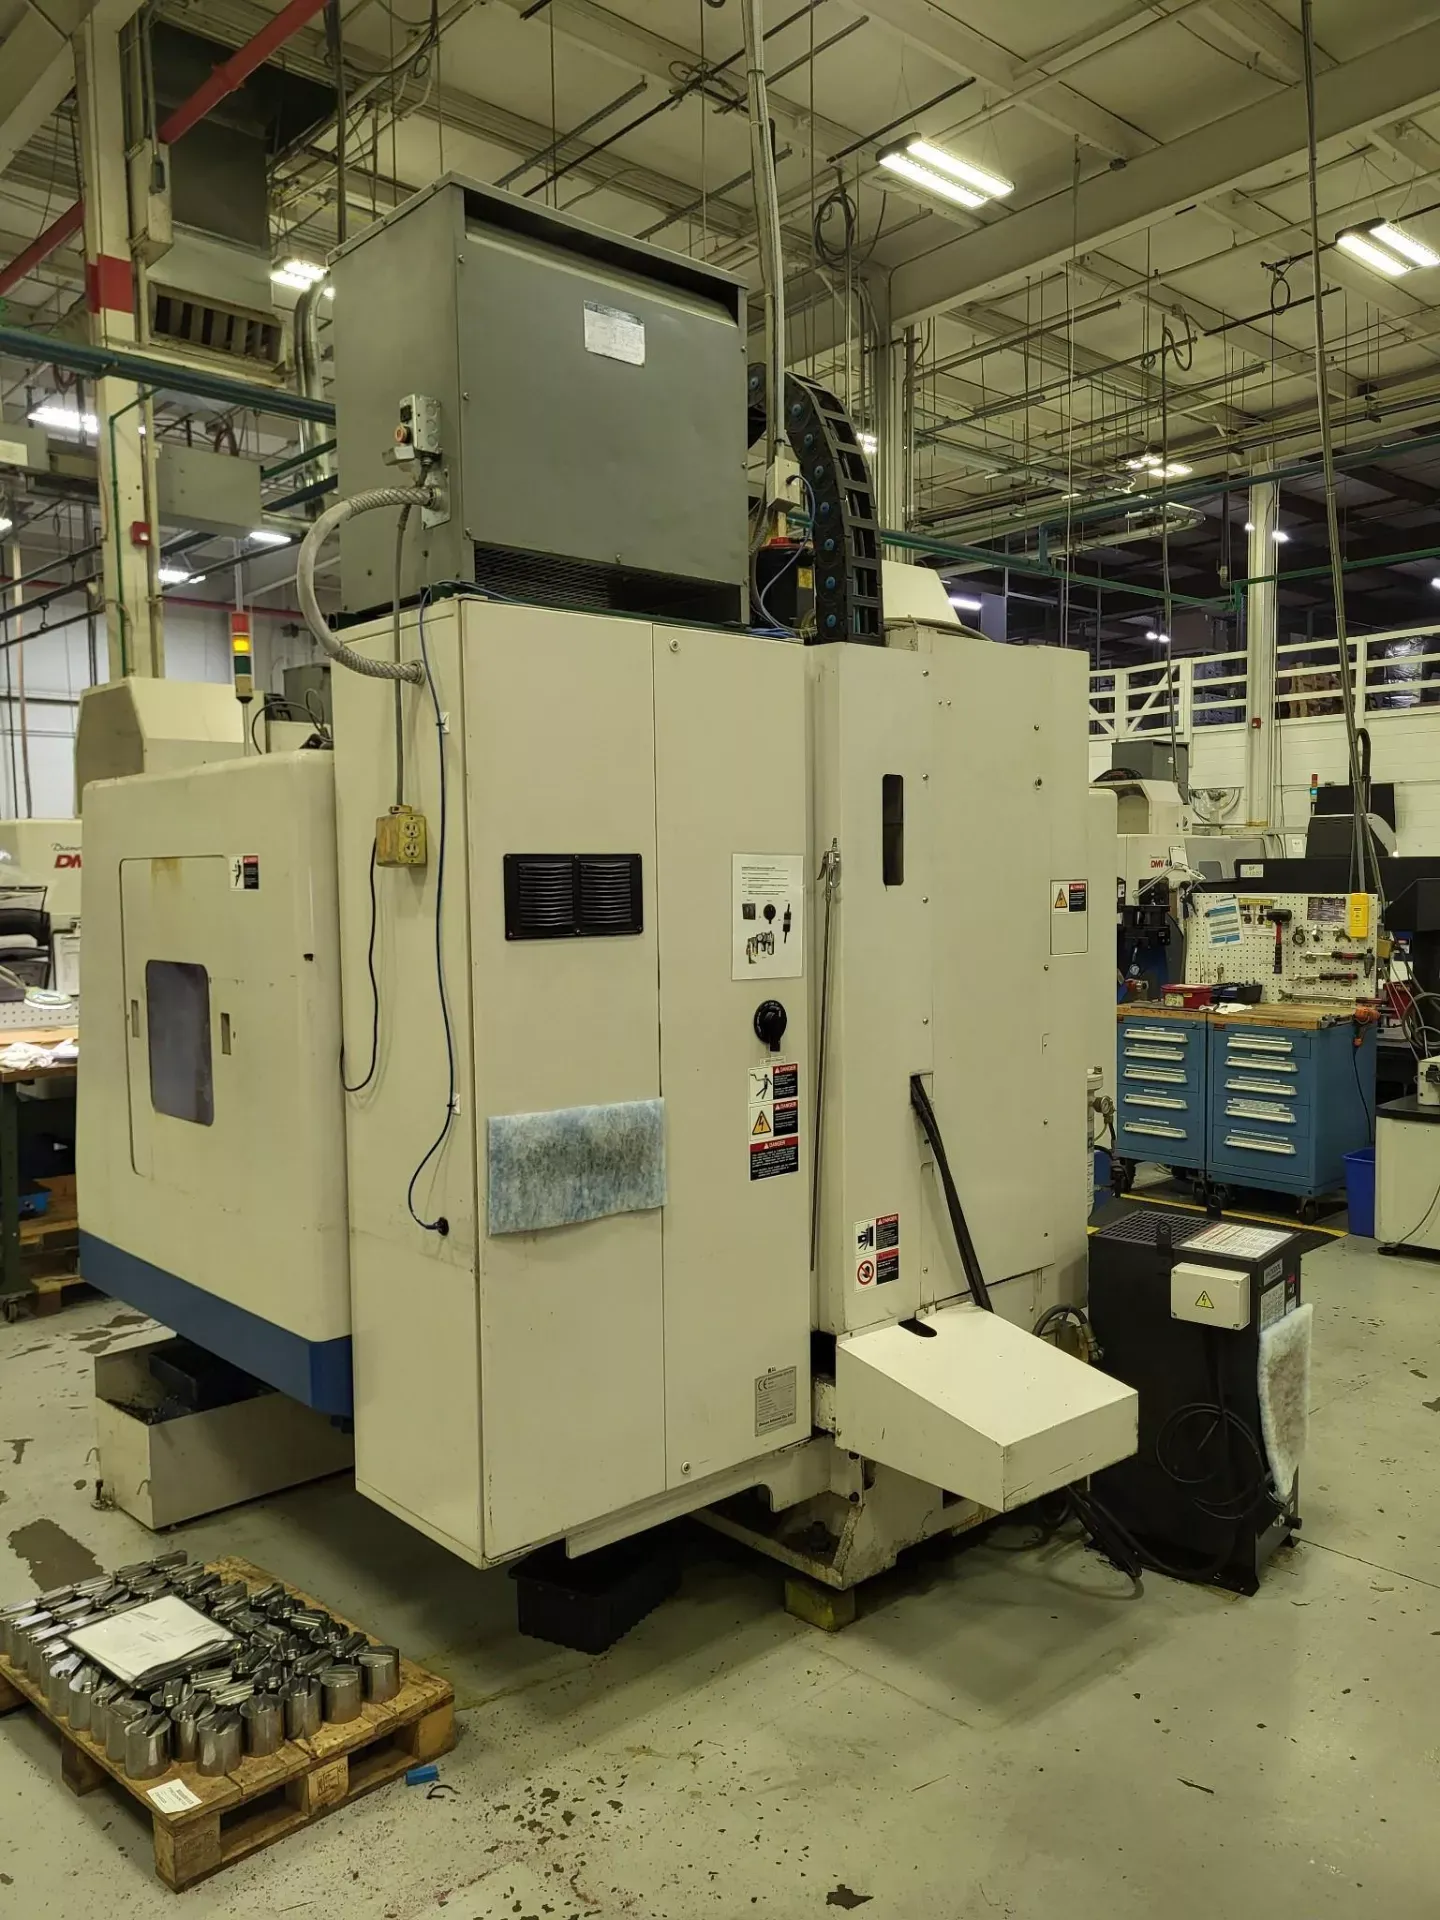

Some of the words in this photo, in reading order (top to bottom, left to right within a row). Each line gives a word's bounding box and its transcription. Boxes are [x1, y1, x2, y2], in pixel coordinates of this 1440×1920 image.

[1151, 860, 1164, 868] DMV
[780, 1101, 797, 1109] DANGER
[769, 1140, 786, 1148] DANGER
